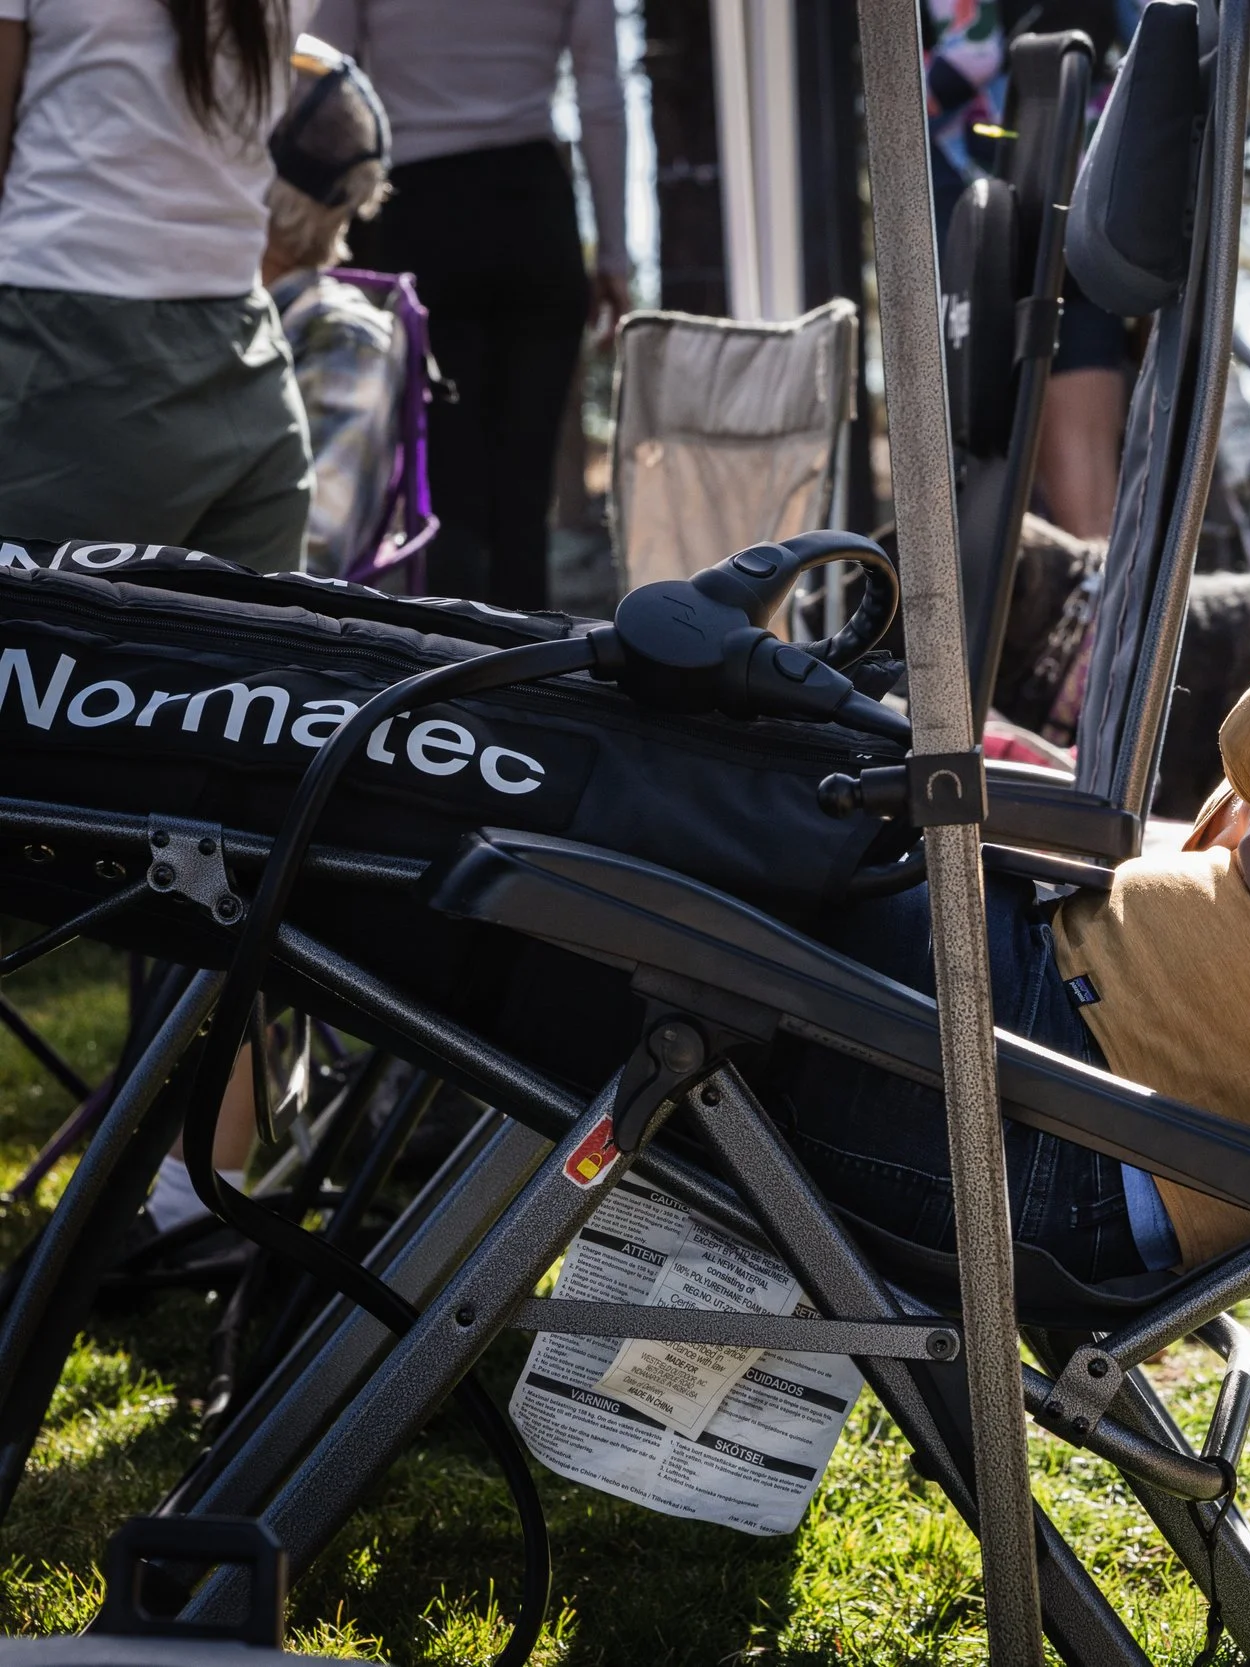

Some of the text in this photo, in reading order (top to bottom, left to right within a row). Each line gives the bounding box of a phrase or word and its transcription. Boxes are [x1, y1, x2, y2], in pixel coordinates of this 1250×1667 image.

[0, 648, 546, 794] Normatec
[621, 1242, 667, 1266] ATTENTI
[693, 1223, 711, 1237] THIS
[750, 1253, 762, 1263] BE
[761, 1258, 796, 1278] REMOVE
[693, 1234, 722, 1252] EXCEPT
[722, 1247, 734, 1257] BY
[748, 1261, 789, 1285] CONSUMER
[642, 1275, 656, 1284] prod
[701, 1251, 769, 1290] ALL NEW MATERIAL
[706, 1266, 756, 1295] consisting of
[673, 1263, 691, 1277] 100%
[689, 1271, 744, 1303] POLYURETHANE
[741, 1298, 762, 1314] FOAM
[641, 1352, 672, 1374] WESTFIELD
[665, 1353, 699, 1374] MADE FOR
[696, 1355, 712, 1367] with
[711, 1361, 726, 1373] law
[716, 1353, 724, 1362] in
[723, 1346, 746, 1362] article
[623, 1375, 638, 1387] Date
[745, 1368, 804, 1397] CUIDADOS
[571, 1388, 620, 1415] VARNING
[627, 1386, 674, 1414] MADE IN CHINA
[686, 1389, 698, 1399] USA
[713, 1439, 766, 1466] SKÖTSEL
[580, 1468, 597, 1479] Chine
[601, 1476, 621, 1487] Hecho
